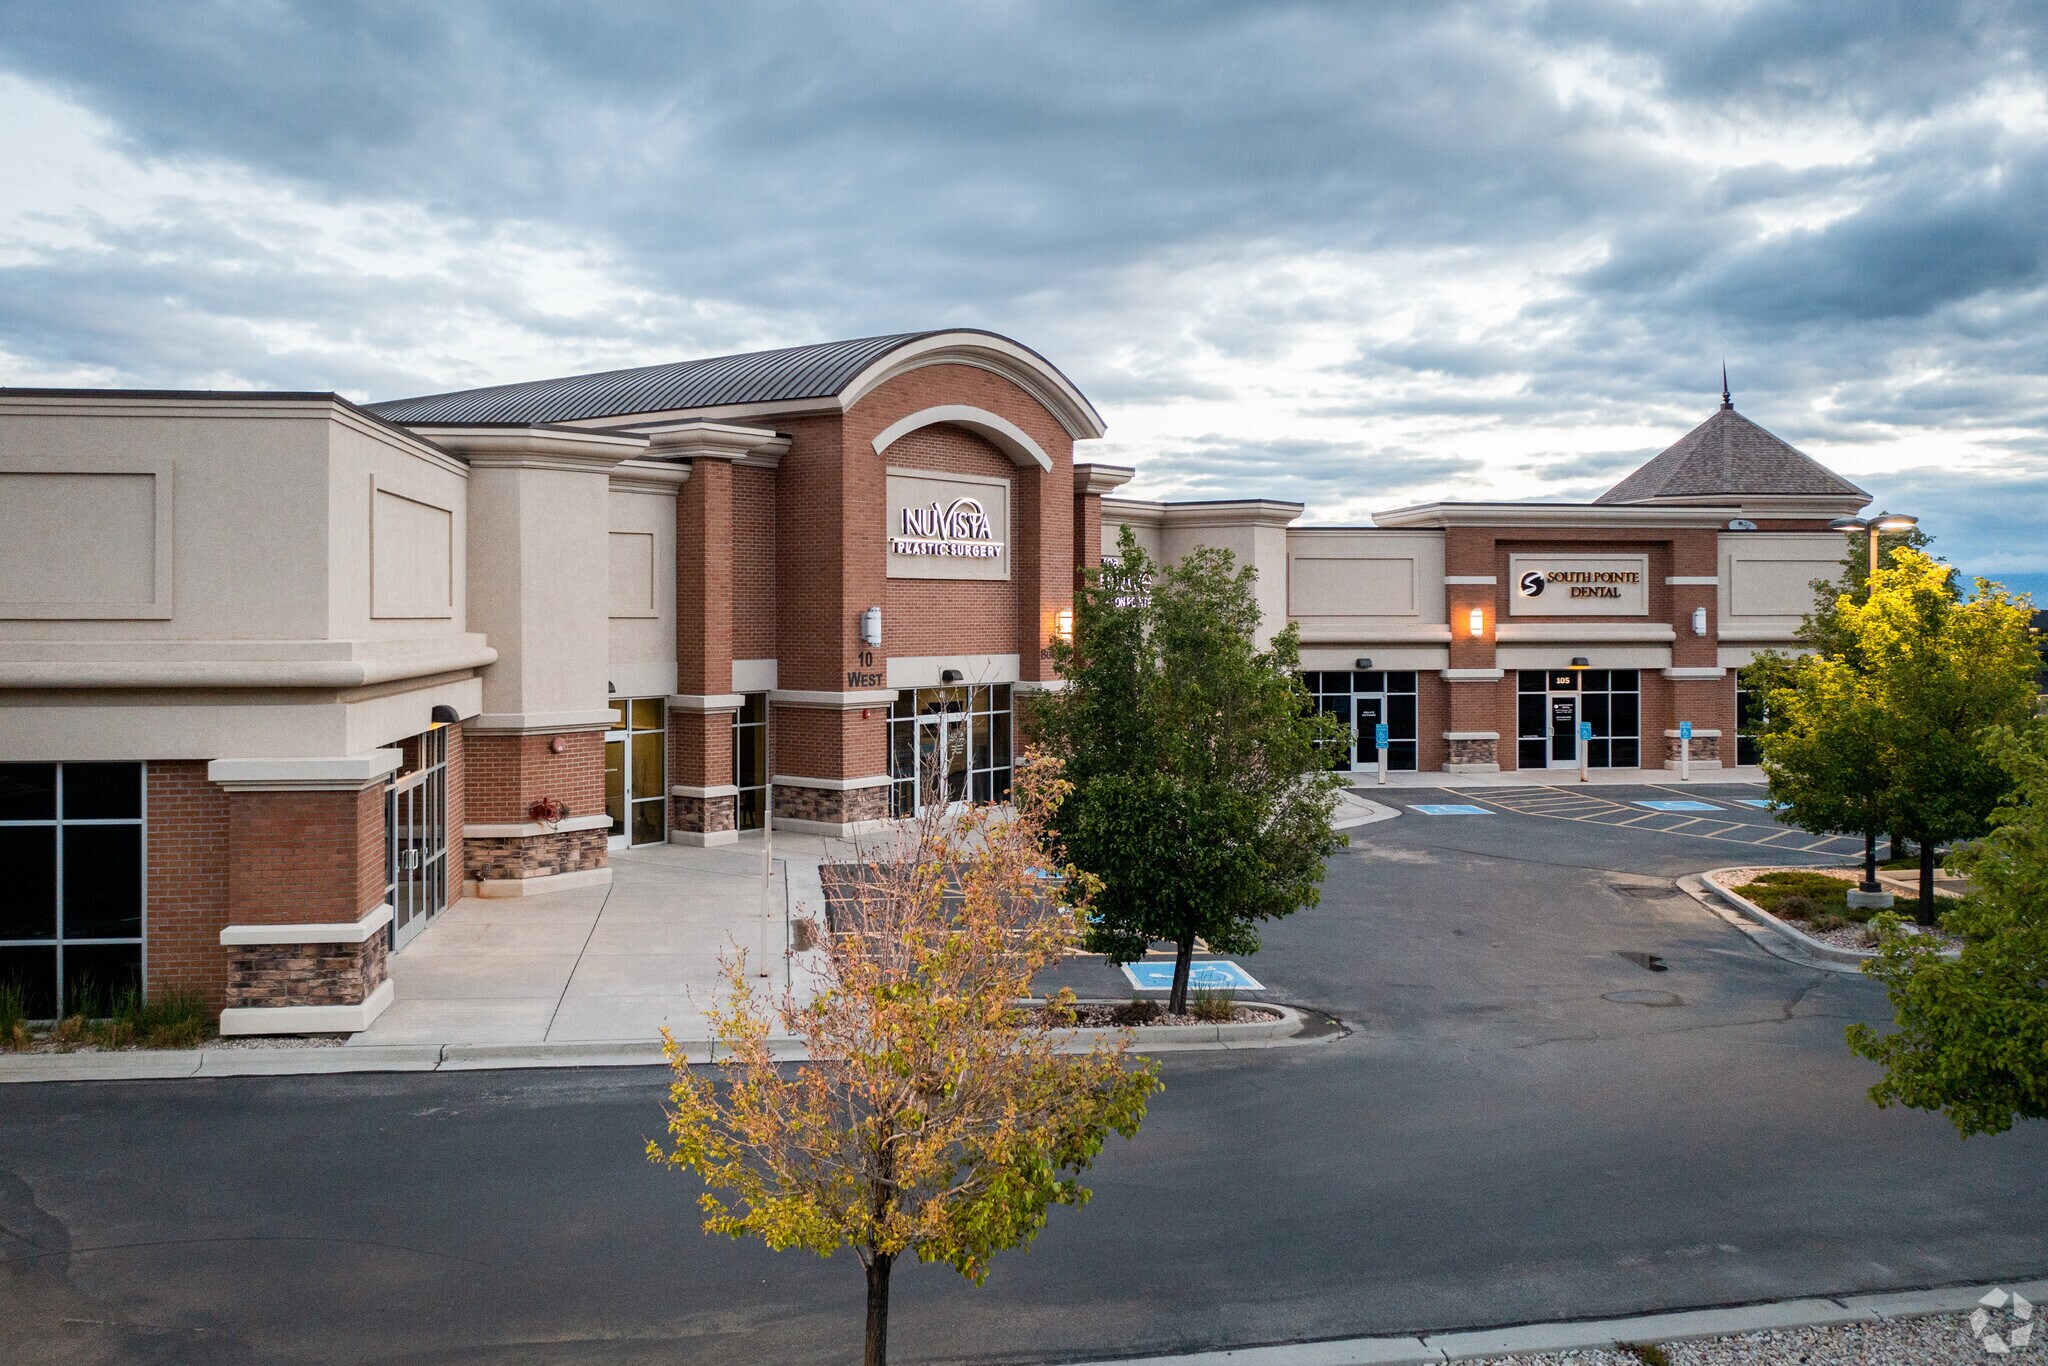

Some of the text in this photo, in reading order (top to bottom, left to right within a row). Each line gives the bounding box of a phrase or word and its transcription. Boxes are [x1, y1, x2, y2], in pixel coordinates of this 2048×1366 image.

[895, 542, 1002, 558] PLASTIC SURGERY
[1547, 571, 1640, 584] SOUTH POINTE
[1570, 586, 1622, 599] DENTAL
[858, 651, 873, 668] 10
[847, 671, 883, 688] WEST
